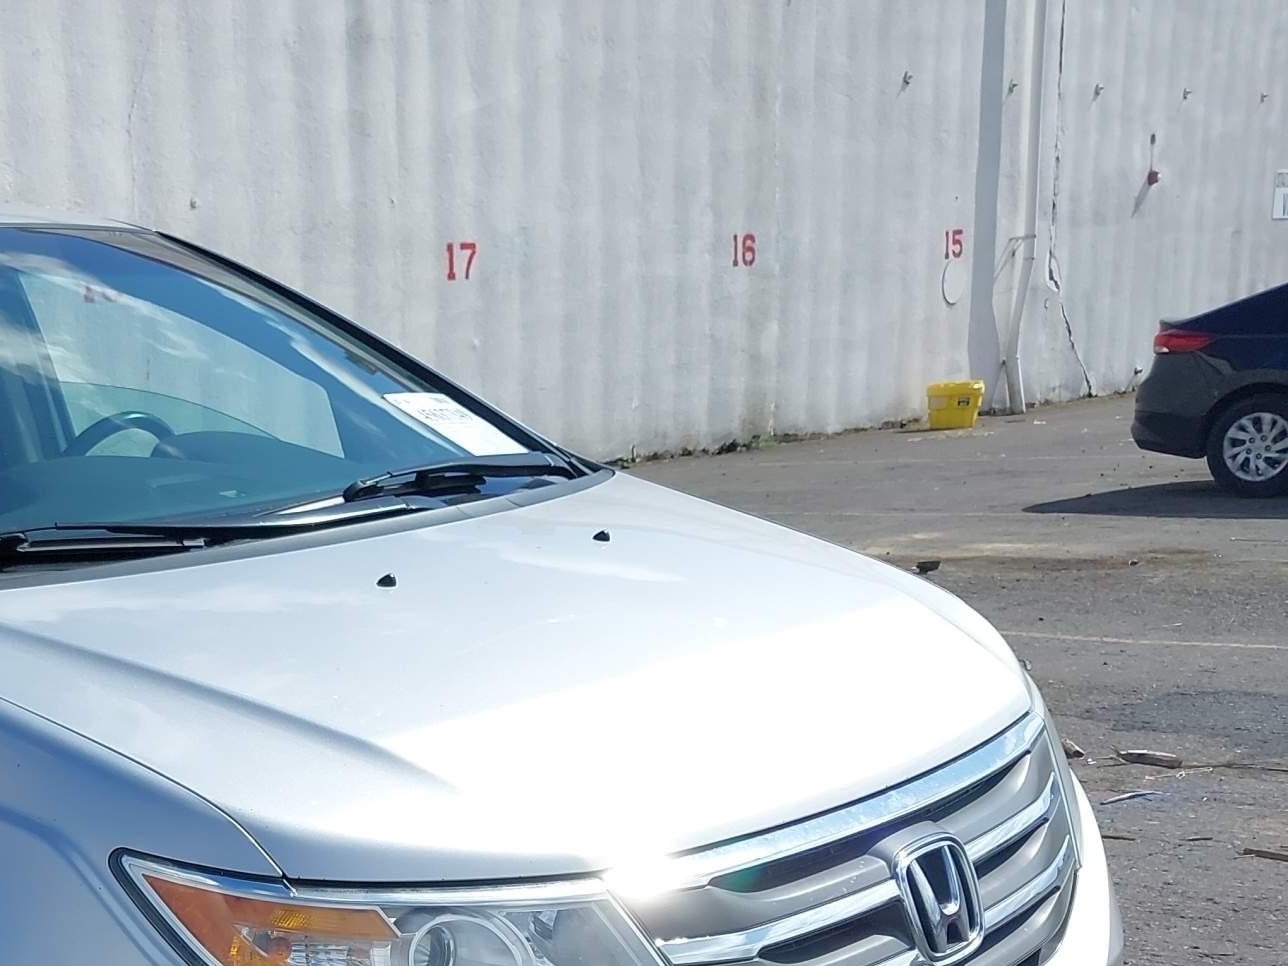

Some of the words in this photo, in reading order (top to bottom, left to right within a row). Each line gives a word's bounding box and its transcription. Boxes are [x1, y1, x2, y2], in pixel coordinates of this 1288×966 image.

[732, 234, 756, 267] 16
[944, 229, 963, 260] 15
[446, 242, 476, 281] 17
